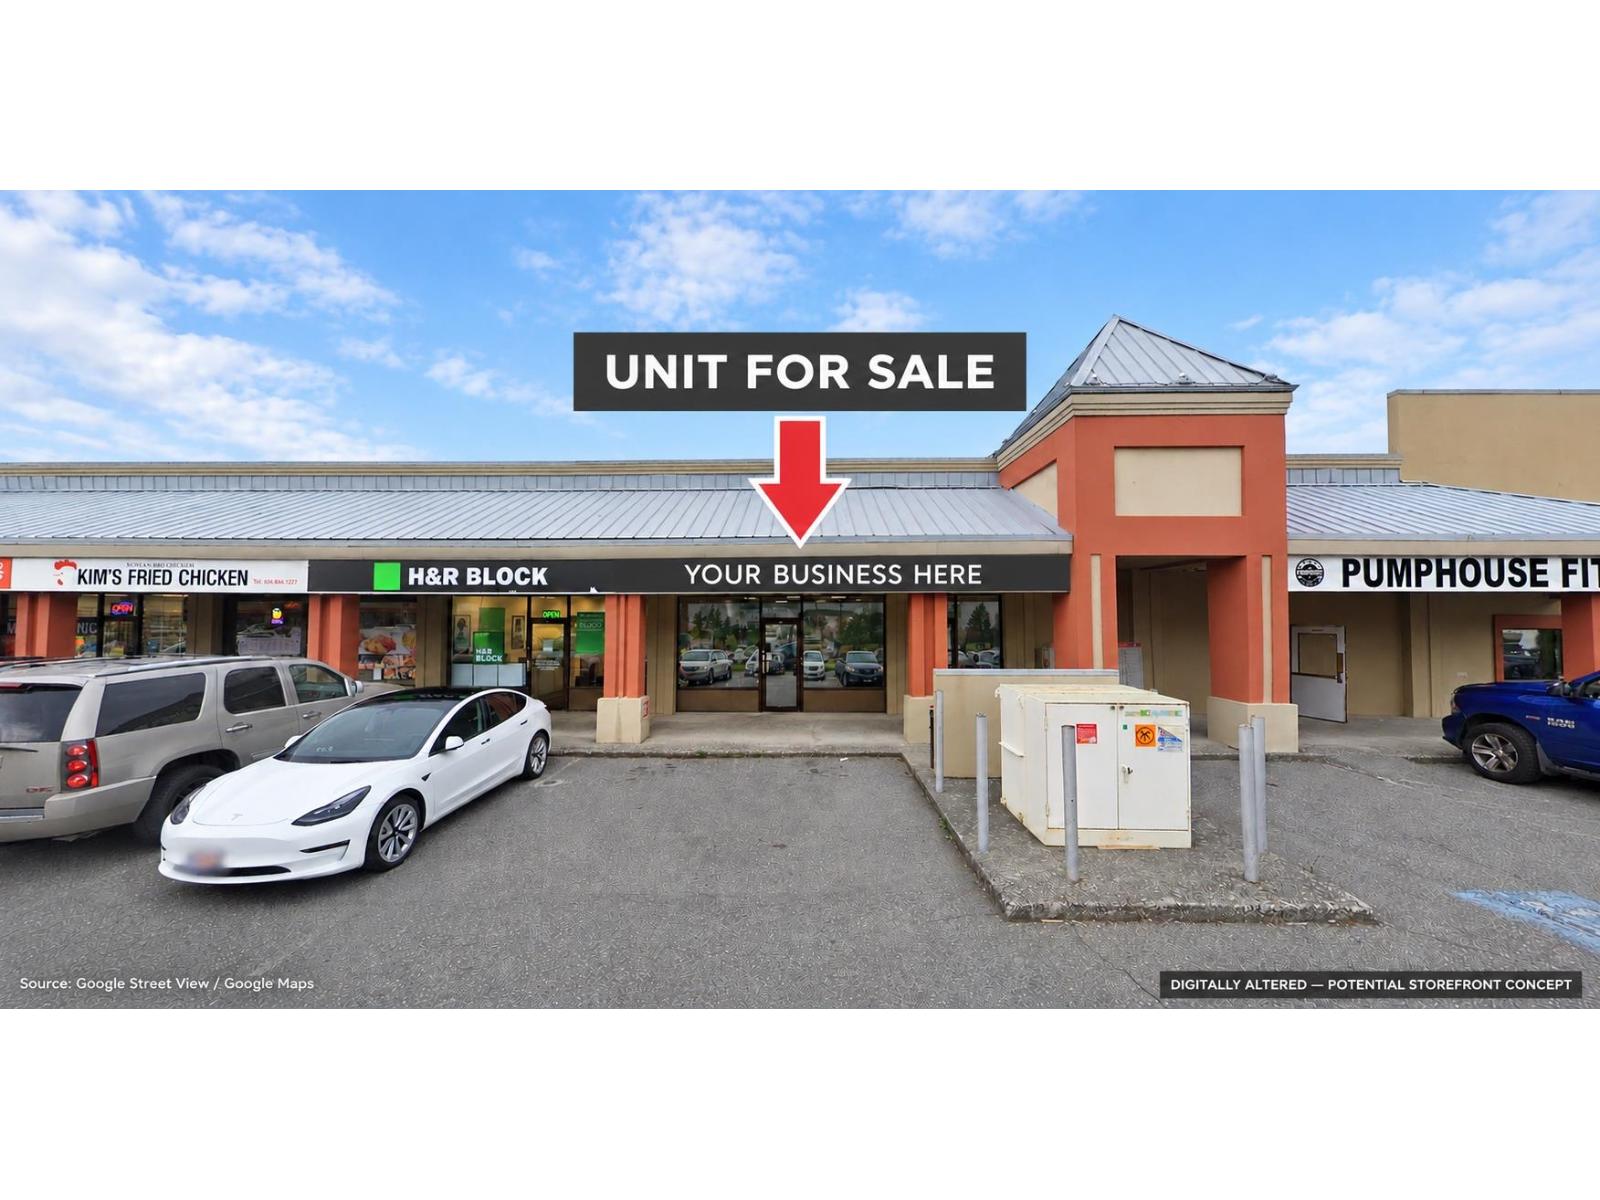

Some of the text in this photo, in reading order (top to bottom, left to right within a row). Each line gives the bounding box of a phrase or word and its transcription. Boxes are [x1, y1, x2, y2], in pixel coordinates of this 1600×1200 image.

[77, 568, 249, 586] KIM'S FRIED CHICKEN
[408, 567, 548, 586] H&R BLOCK
[684, 563, 982, 585] YOUR BUSINESS HERE
[1341, 557, 1549, 588] PUMPHOUSE
